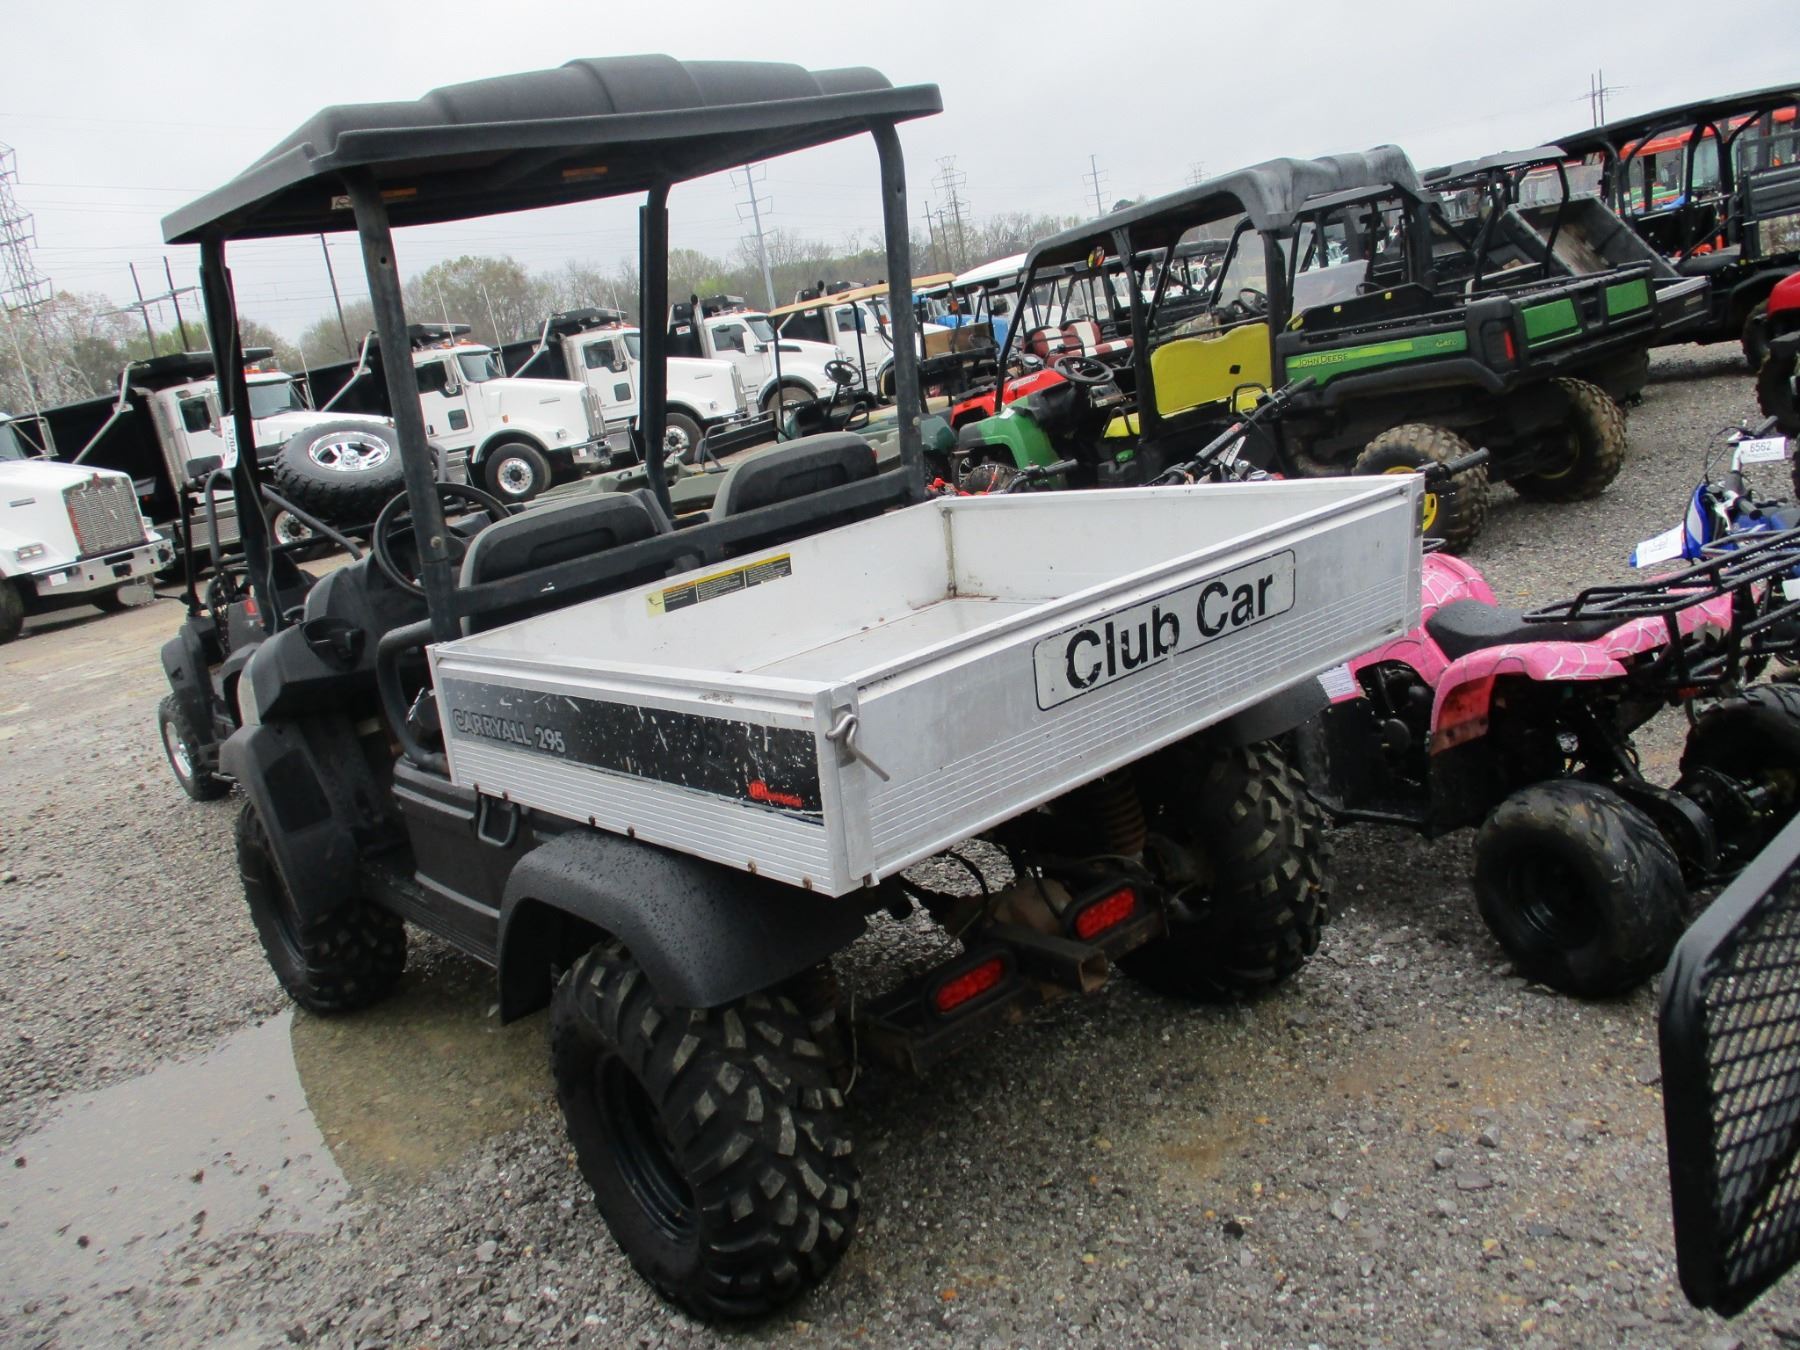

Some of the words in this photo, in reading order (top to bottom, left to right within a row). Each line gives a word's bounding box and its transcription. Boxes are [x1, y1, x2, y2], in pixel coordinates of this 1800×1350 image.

[1298, 357, 1319, 369] JOHN
[1320, 353, 1348, 364] DEERE
[1065, 603, 1180, 689] Club
[1196, 573, 1273, 638] Car
[452, 708, 532, 746] CARRYALL
[534, 725, 566, 753] 295
